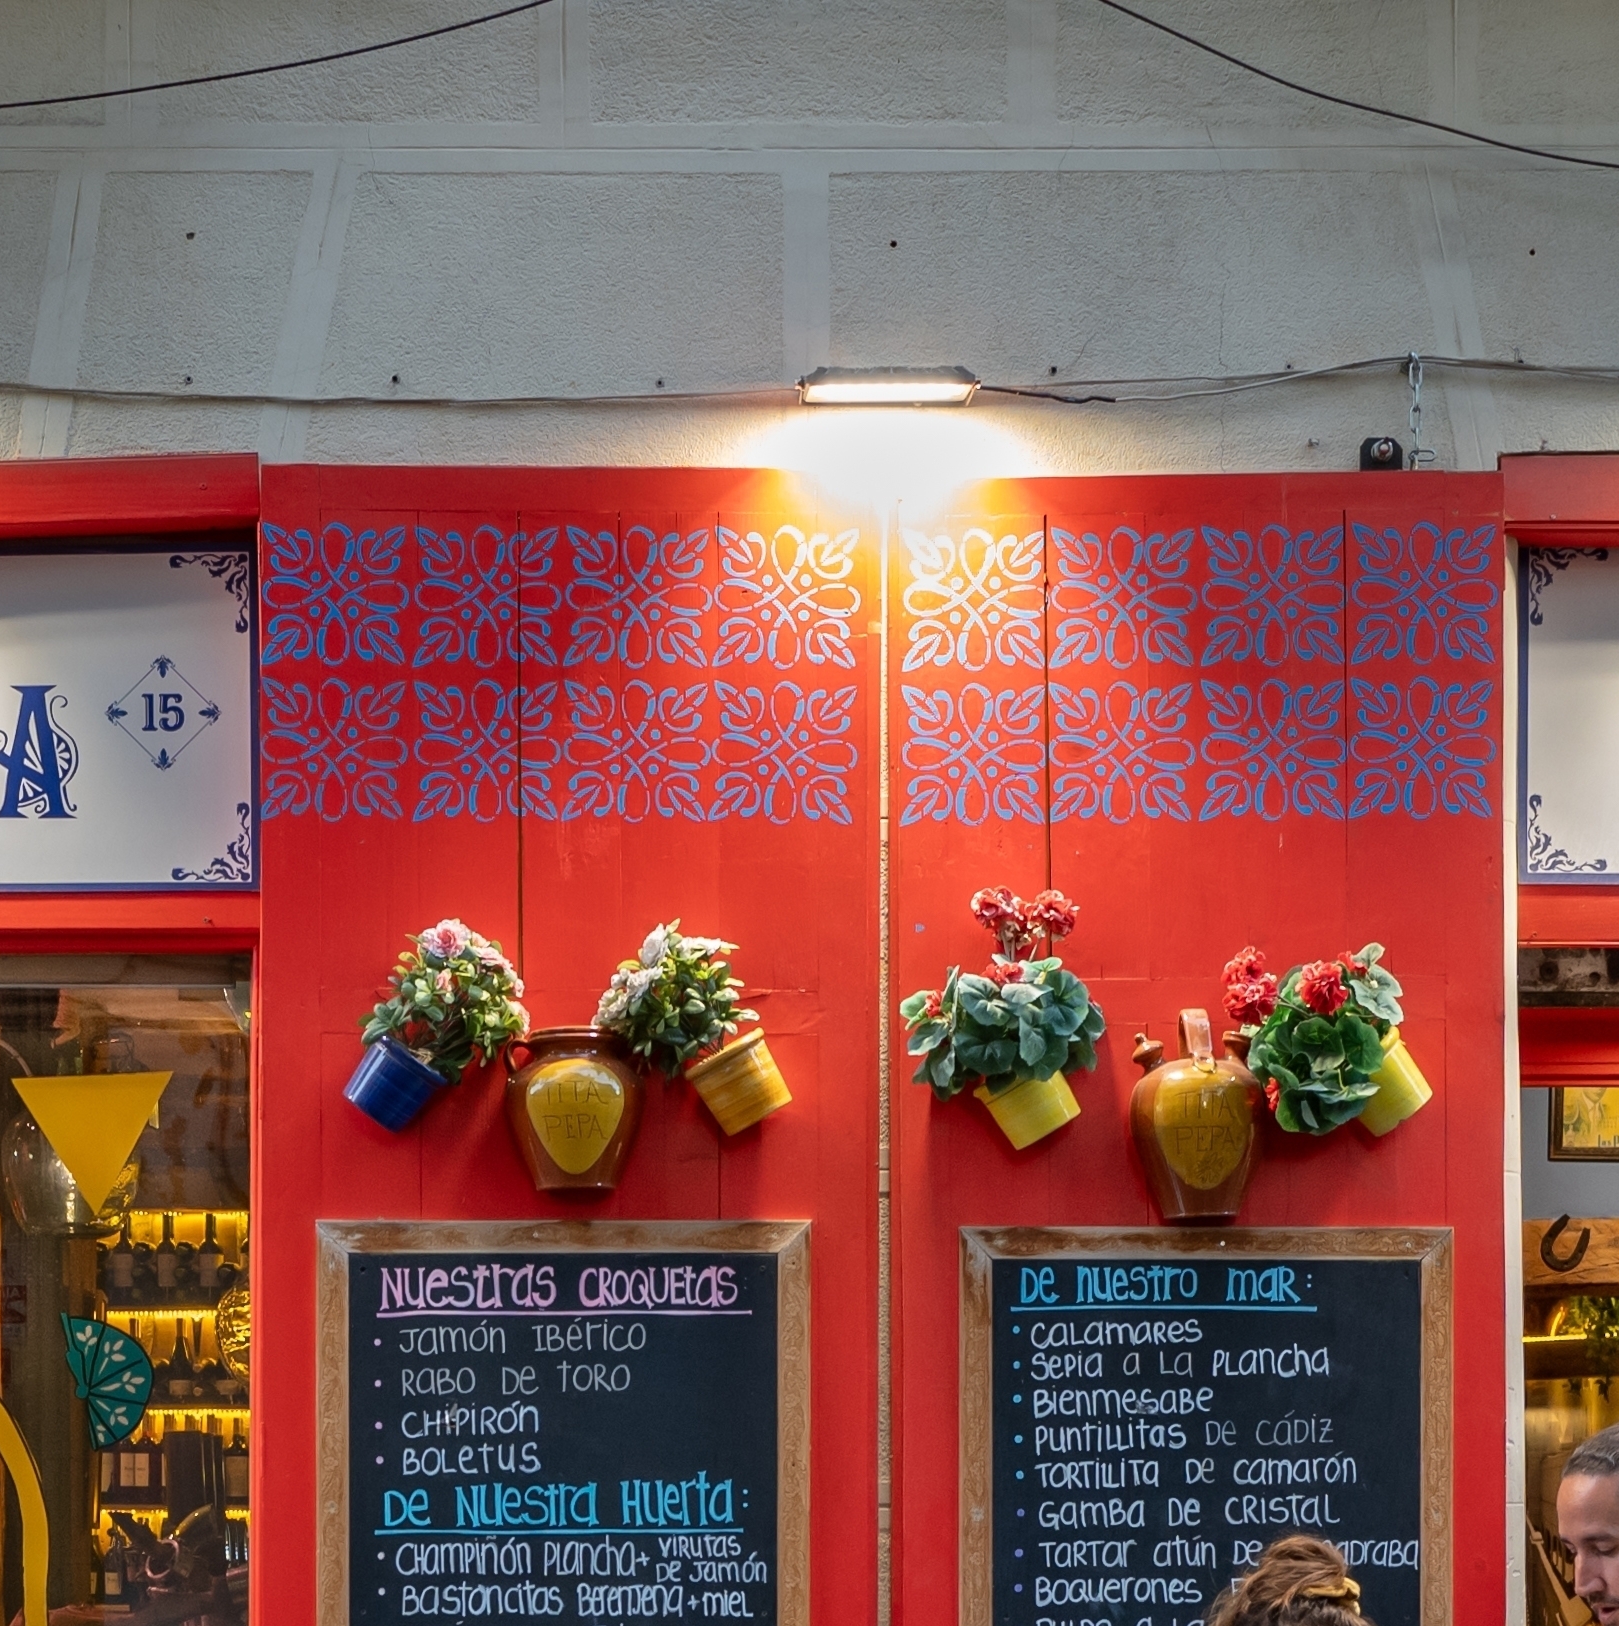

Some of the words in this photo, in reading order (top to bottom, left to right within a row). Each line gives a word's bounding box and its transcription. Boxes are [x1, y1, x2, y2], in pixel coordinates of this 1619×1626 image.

[141, 692, 186, 734] 15
[1233, 1451, 1357, 1484] camarón
[1153, 1534, 1216, 1568] atún
